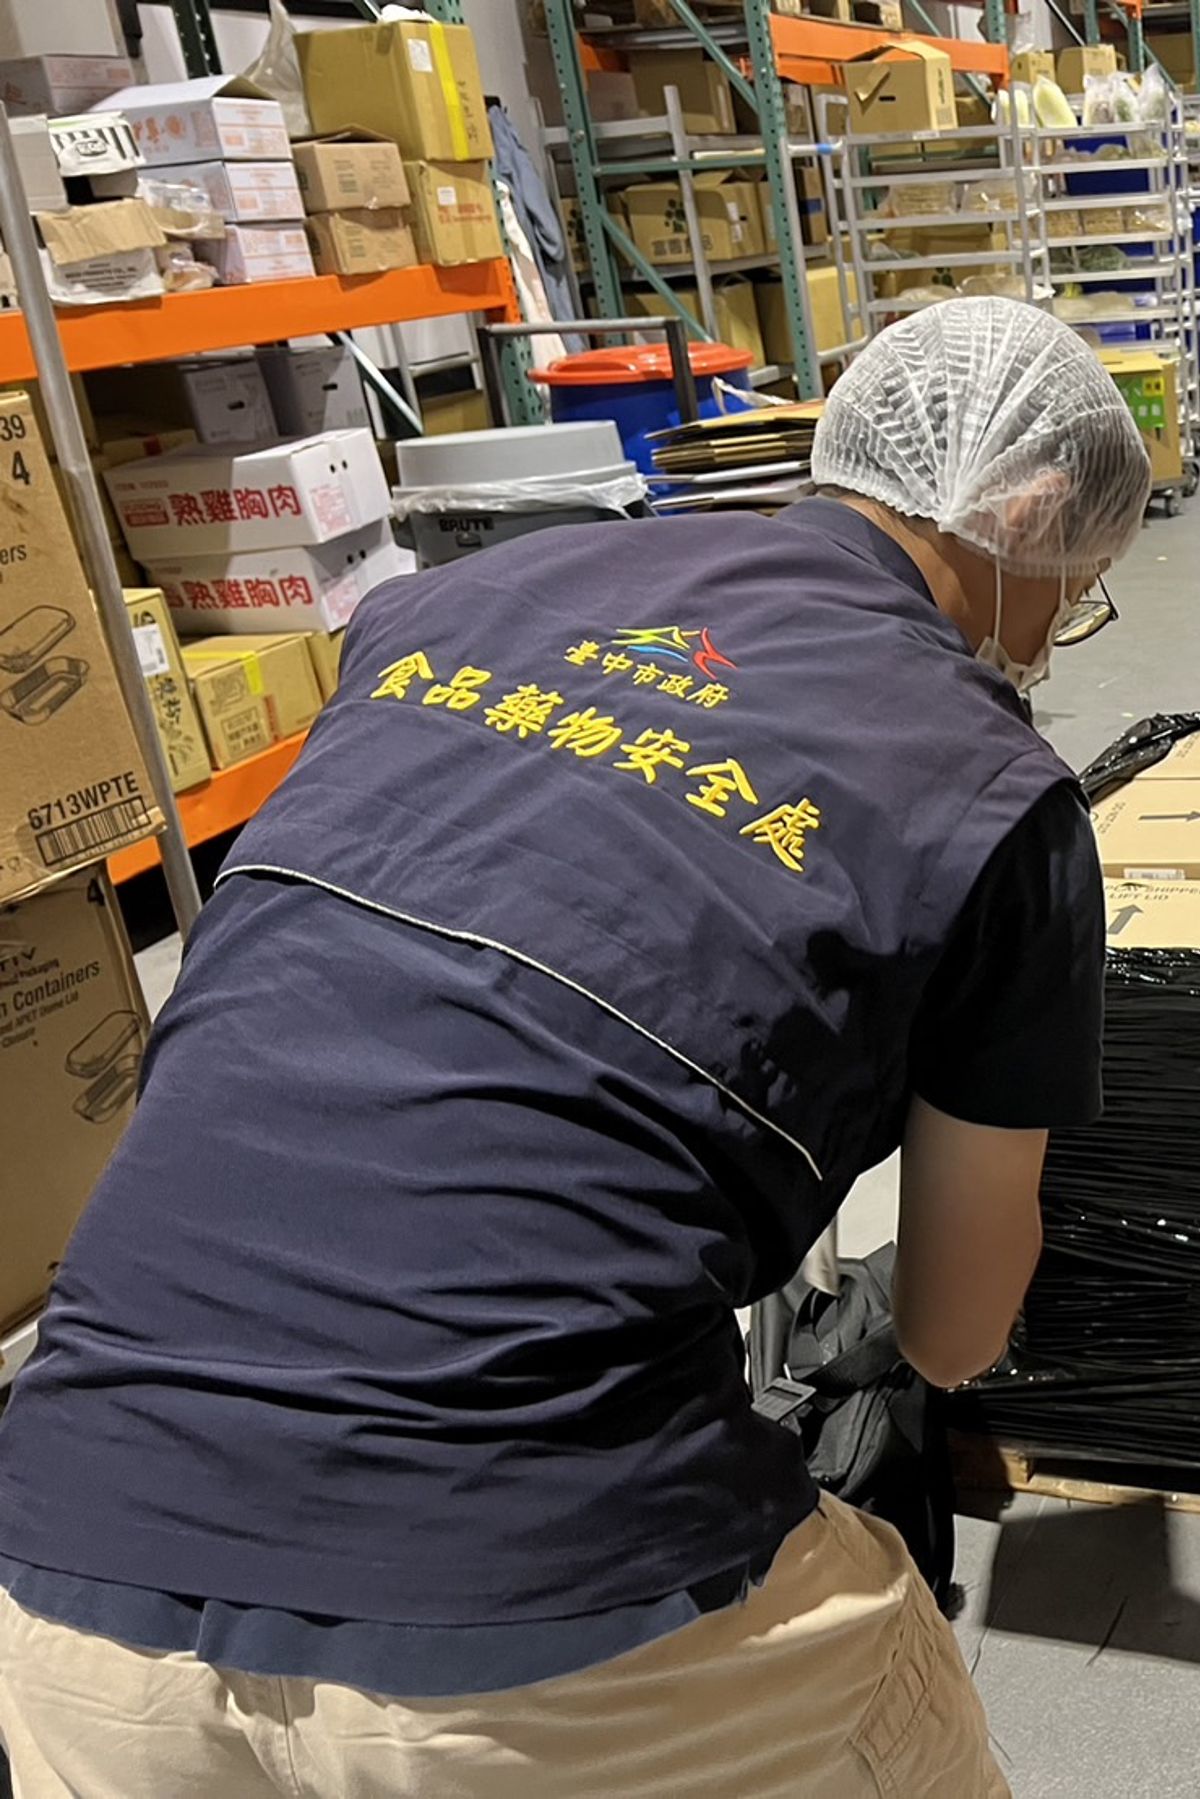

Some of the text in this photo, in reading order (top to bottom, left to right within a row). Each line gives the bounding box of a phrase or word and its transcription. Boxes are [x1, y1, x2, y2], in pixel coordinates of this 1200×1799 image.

[12, 450, 31, 486] 4
[168, 484, 303, 526] 熟雞胸肉
[440, 516, 495, 533] BRUTE
[180, 574, 314, 610] 熟雞胸肉
[370, 650, 821, 872] 食品藥物安全處
[28, 771, 139, 830] 6713WPTE
[13, 961, 100, 1012] Containers
